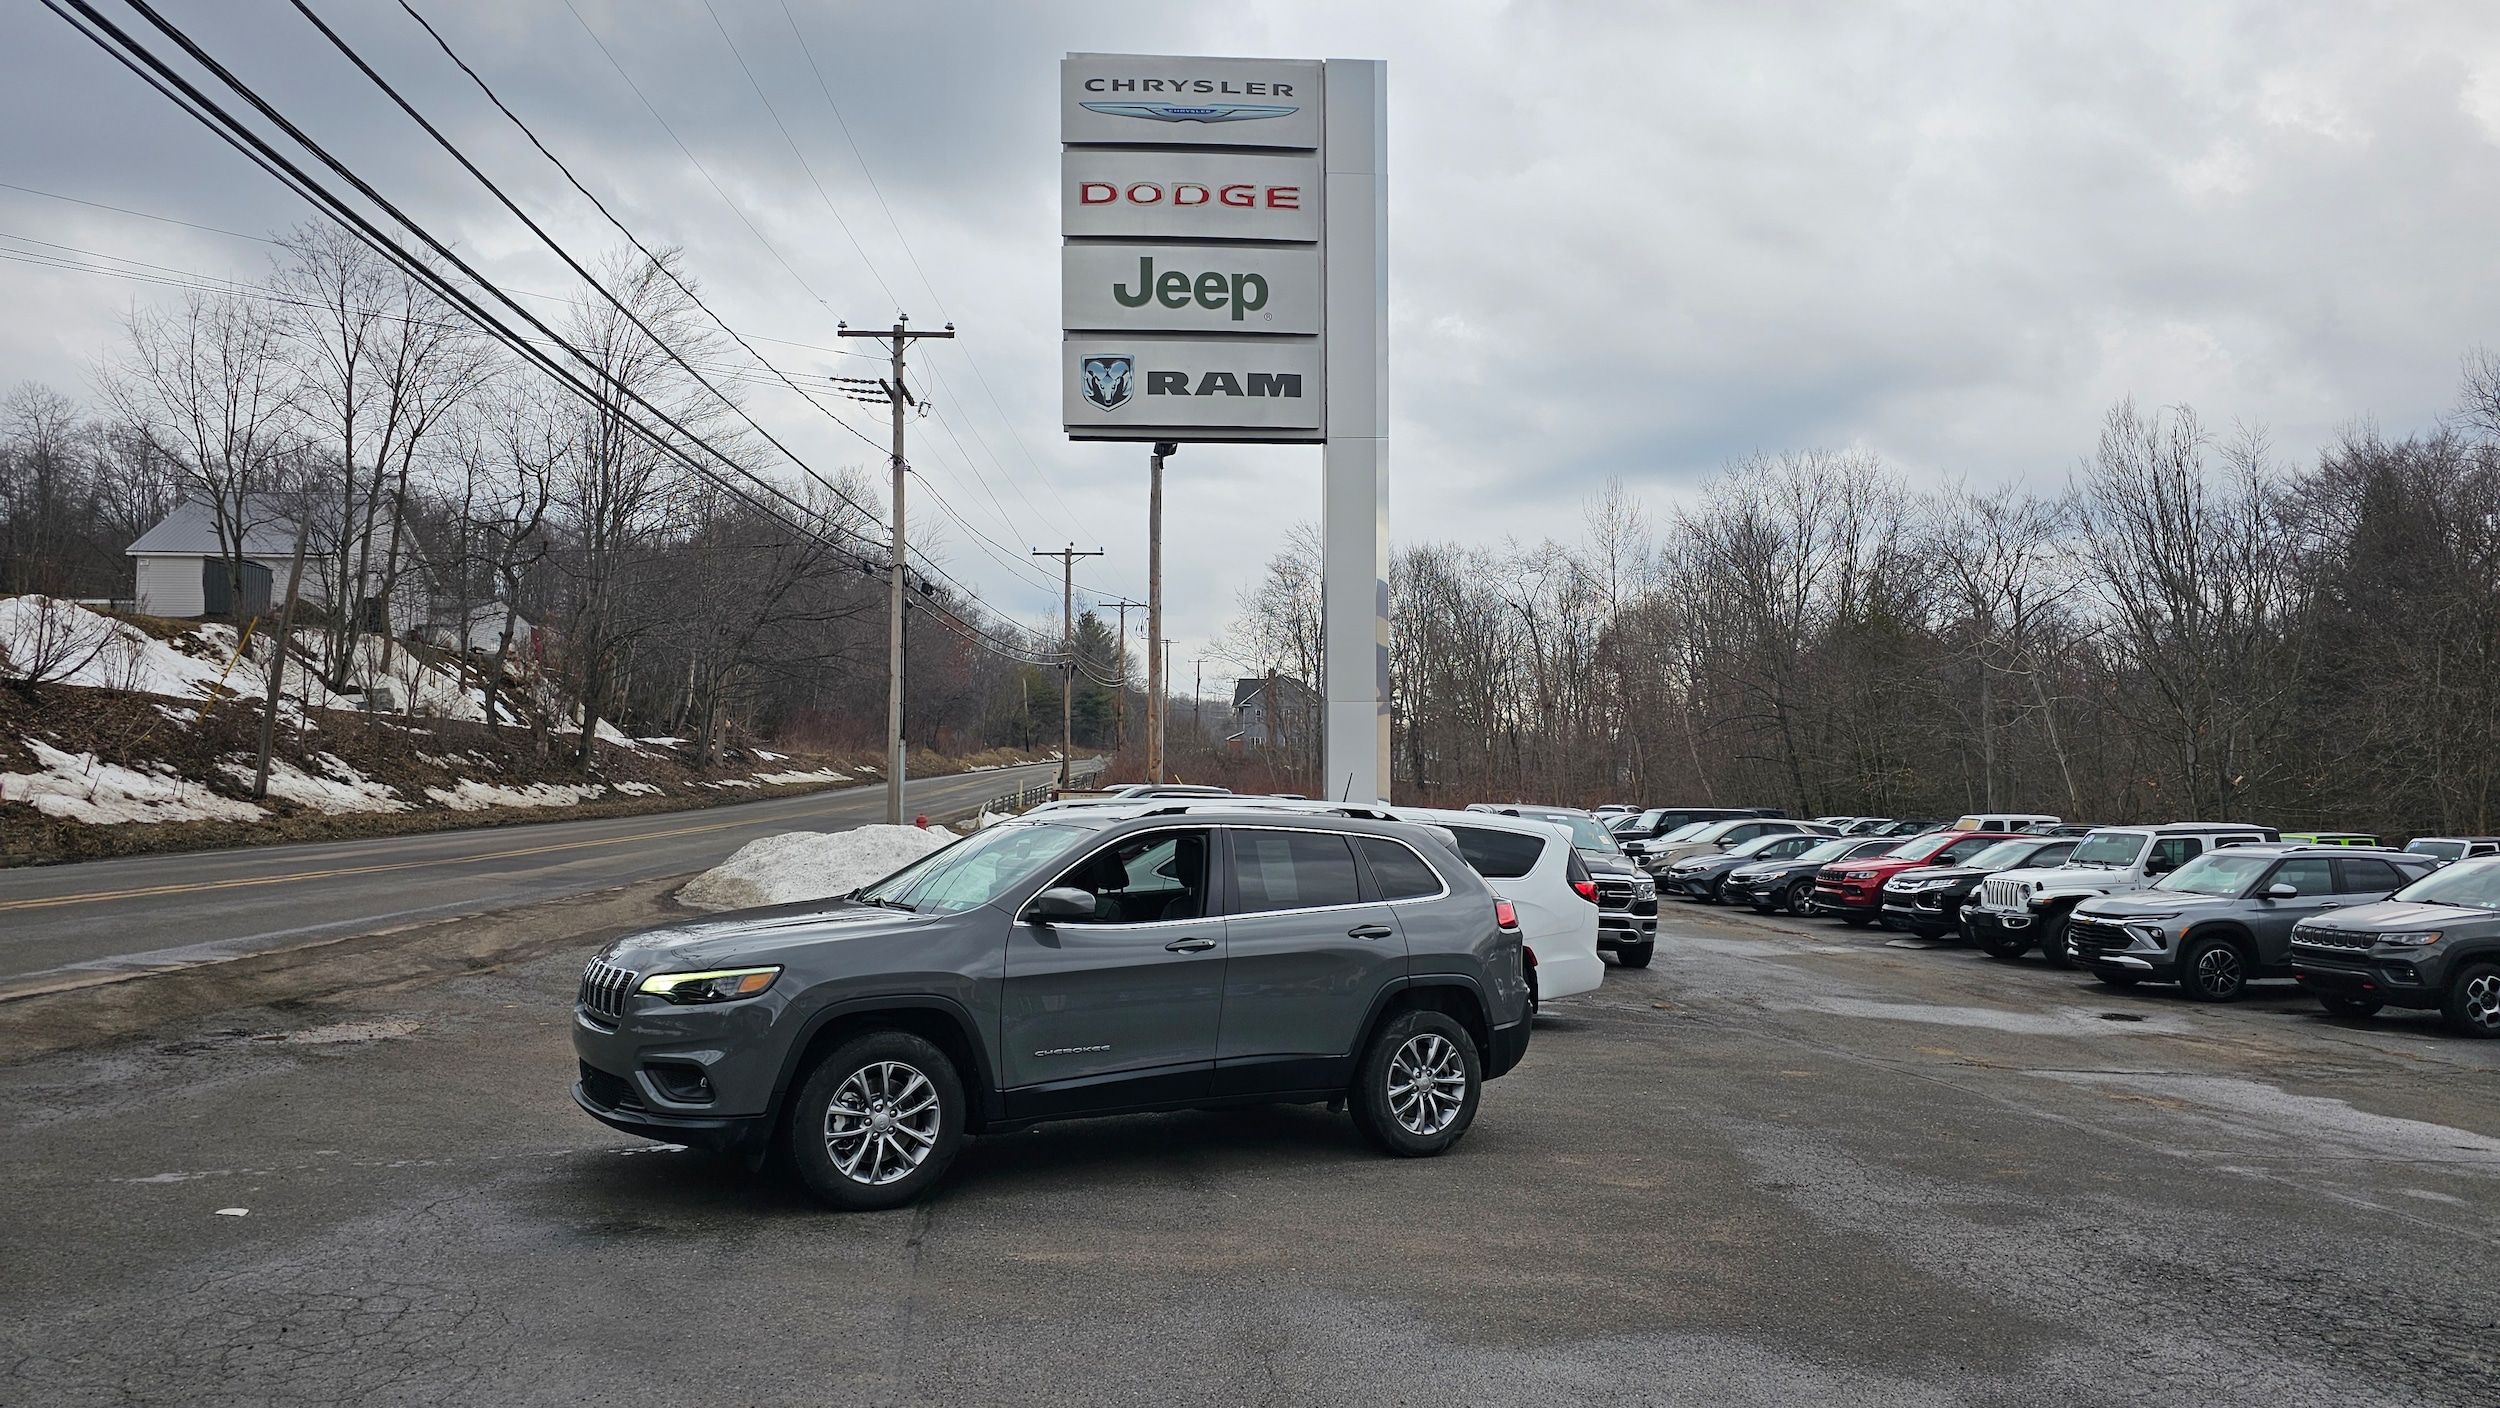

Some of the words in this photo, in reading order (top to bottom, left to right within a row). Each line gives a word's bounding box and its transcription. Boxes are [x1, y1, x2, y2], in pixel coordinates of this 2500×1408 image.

[1084, 78, 1294, 97] CHRYSLER
[1080, 182, 1300, 211] DODGE
[1113, 256, 1268, 321] Jeep
[1147, 371, 1302, 398] RAM
[1034, 1044, 1111, 1057] CHEROKEE
